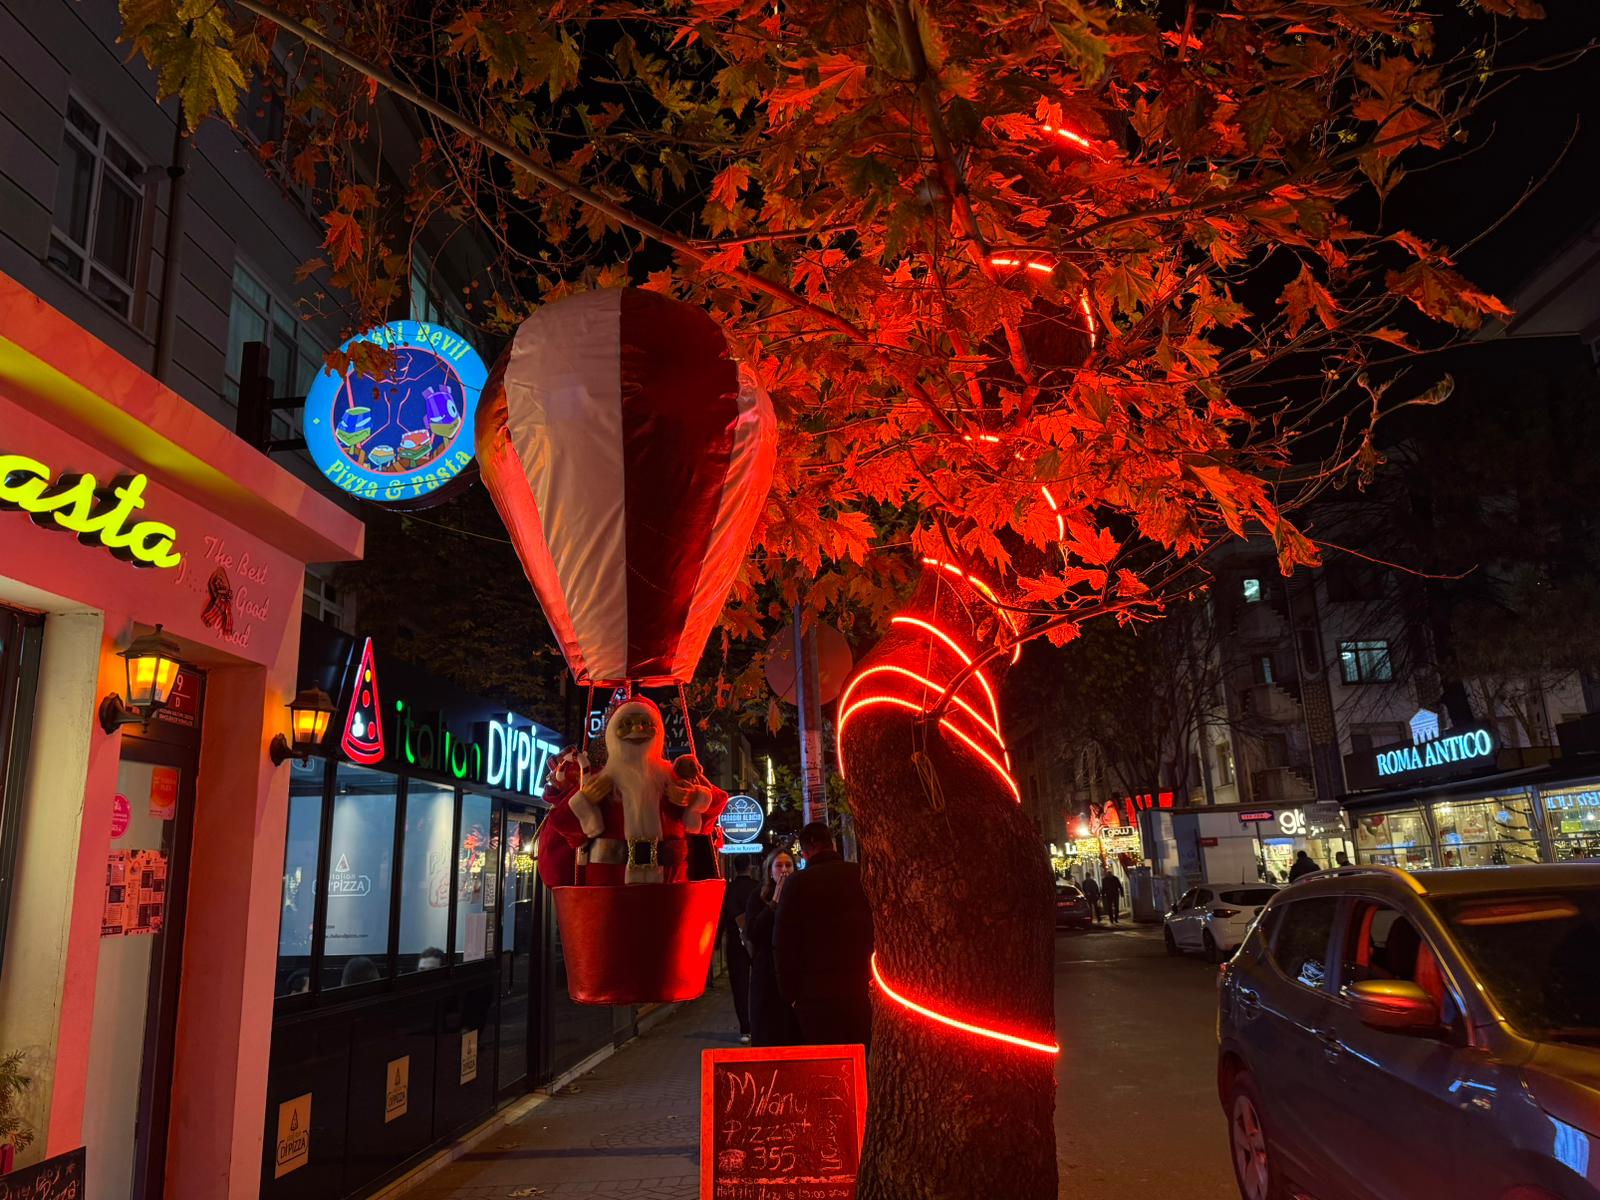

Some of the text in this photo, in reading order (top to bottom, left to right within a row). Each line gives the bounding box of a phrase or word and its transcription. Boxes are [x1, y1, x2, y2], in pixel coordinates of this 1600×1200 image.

[325, 450, 473, 500] Pizza & Pasta
[204, 534, 269, 586] The Best
[235, 584, 270, 623] Good
[394, 700, 482, 782] italian
[1375, 728, 1493, 777] ROMA ANTICO
[750, 1145, 797, 1172] 355
